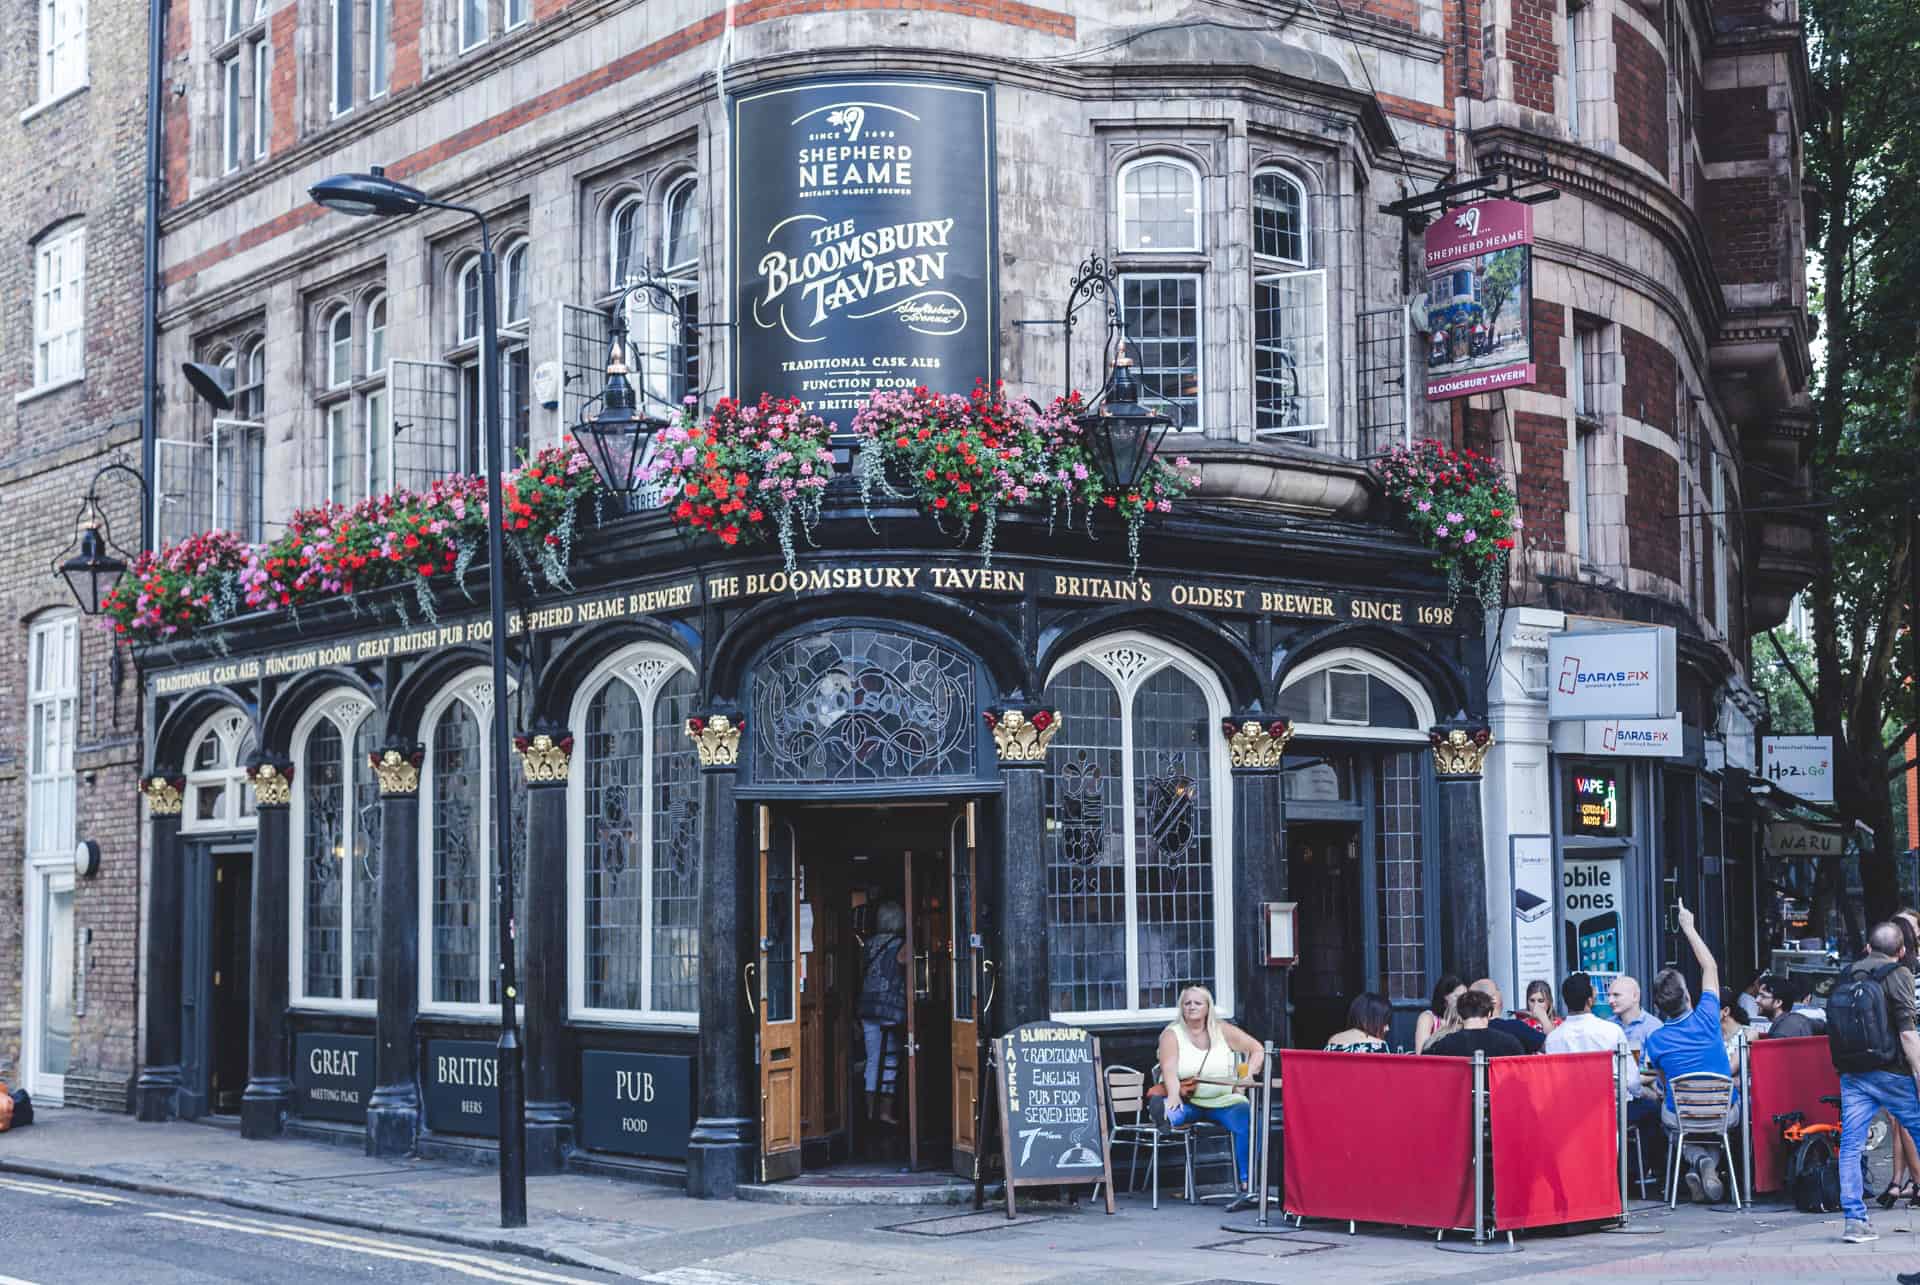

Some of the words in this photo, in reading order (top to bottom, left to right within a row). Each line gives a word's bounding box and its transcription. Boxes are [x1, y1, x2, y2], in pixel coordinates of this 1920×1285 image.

[808, 132, 840, 141] SINCE
[799, 145, 912, 164] SHEPHERD
[799, 162, 912, 188] NEAME
[811, 219, 856, 246] THE
[1427, 239, 1484, 262] SHEPHERD
[1486, 230, 1525, 248] NEAME
[758, 217, 954, 307] BLOOMSBURY
[801, 252, 949, 327] TAVERN
[781, 357, 867, 372] TRADITIONAL
[872, 357, 908, 367] CASK
[911, 357, 941, 368] ALES
[802, 378, 871, 391] FUNCTION
[875, 378, 917, 388] ROOM
[1428, 376, 1488, 395] BLOOMSBURY
[1490, 369, 1526, 383] TAVERN
[709, 576, 739, 599] THE
[745, 567, 922, 595] BLOOMSBURY
[929, 567, 1025, 592] TAVERN
[577, 597, 625, 622] NEAME
[629, 584, 694, 614] BREWERY
[1055, 575, 1152, 601] BRITAIN'S
[1171, 585, 1245, 609] OLDEST
[1261, 592, 1335, 616] BREWER
[1351, 599, 1403, 622] SINCE
[1416, 605, 1454, 626] 1698
[357, 638, 391, 659] GREAT
[393, 629, 437, 653] BRITISH
[439, 625, 463, 645] PUB
[467, 620, 493, 641] FOO
[265, 652, 316, 675] FUNCTION
[319, 645, 351, 666] ROOM
[156, 669, 210, 693] TRADITIONAL
[213, 665, 237, 684] CASK
[239, 661, 260, 678] ALES
[1575, 777, 1605, 795] VAPE
[1780, 835, 1831, 851] NARU
[1564, 865, 1611, 888] obile
[1566, 893, 1614, 910] ones
[310, 1047, 359, 1077] GREAT
[1004, 1033, 1020, 1113] TAVERN
[616, 1070, 655, 1103] PUB
[1032, 1068, 1081, 1086] ENGLISH
[310, 1087, 340, 1101] MEETING
[340, 1090, 360, 1104] PLACE
[461, 1100, 483, 1114] BEERS
[1028, 1089, 1051, 1106] PUB
[1054, 1089, 1081, 1106] FOOD
[622, 1117, 648, 1133] FOOD
[1024, 1107, 1063, 1124] SERVED
[1065, 1107, 1089, 1123] HERE
